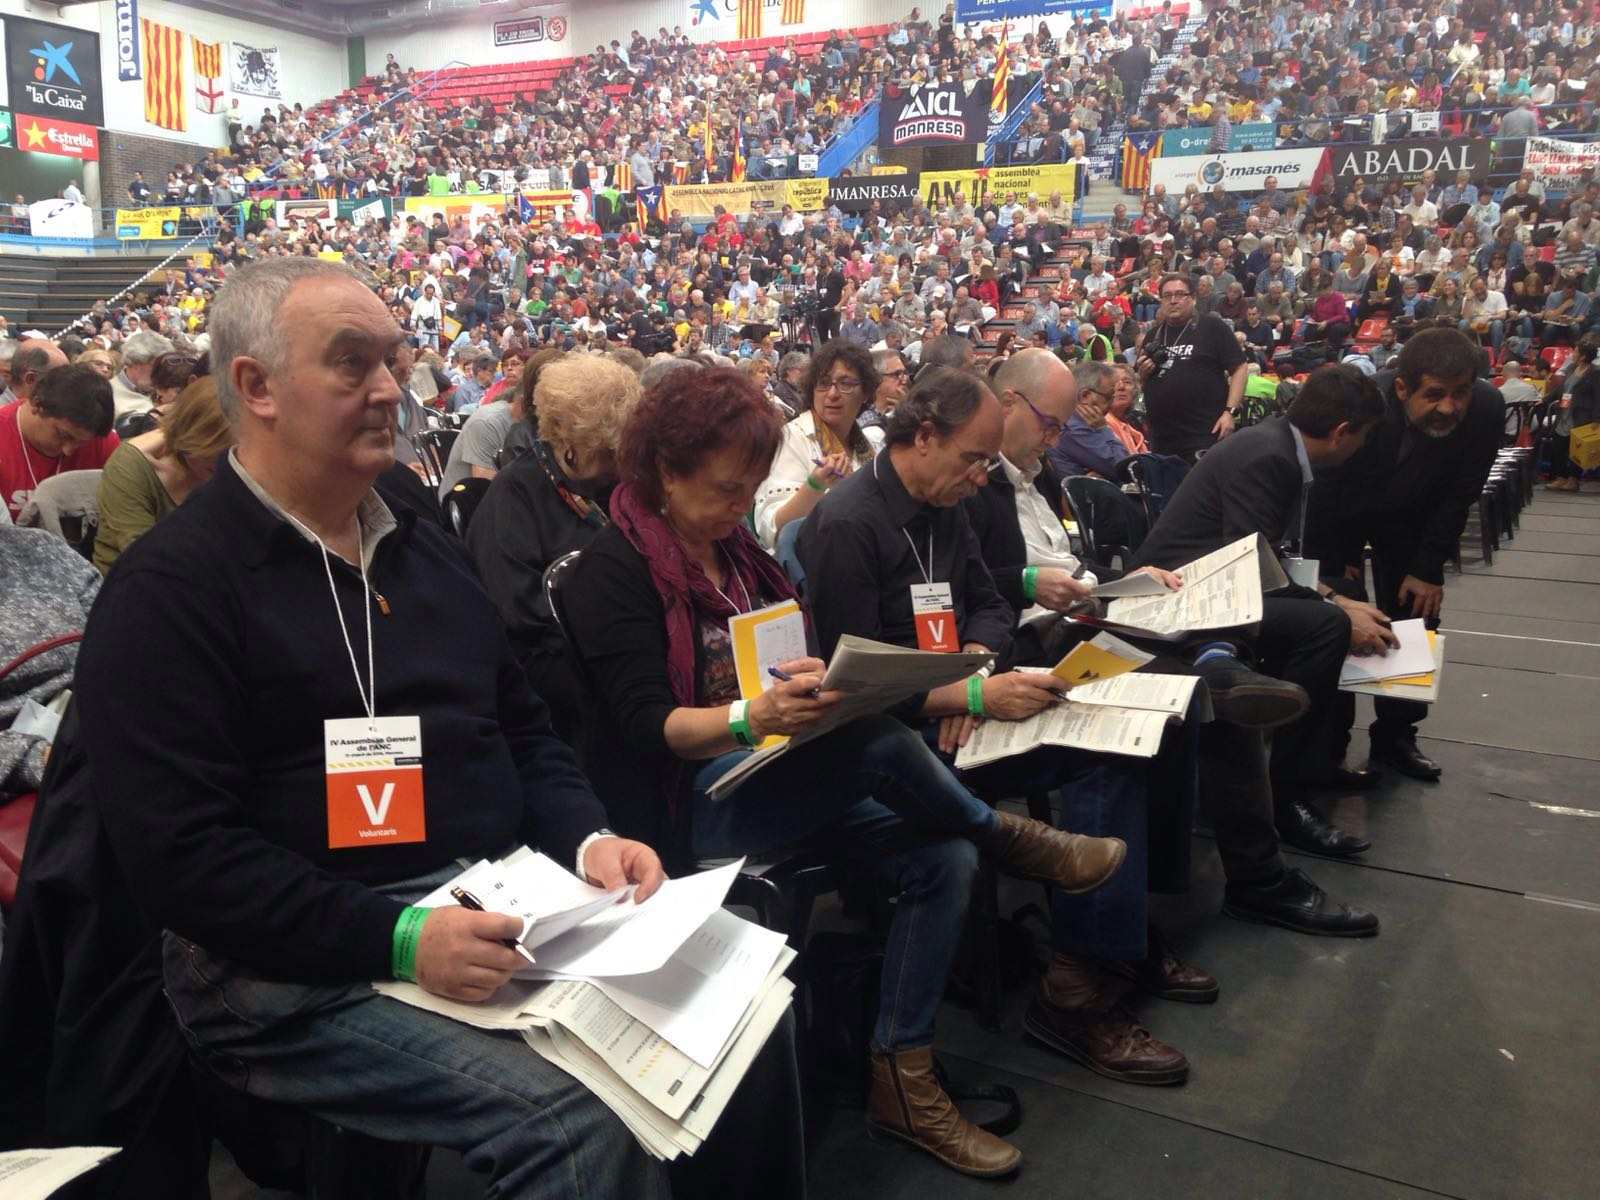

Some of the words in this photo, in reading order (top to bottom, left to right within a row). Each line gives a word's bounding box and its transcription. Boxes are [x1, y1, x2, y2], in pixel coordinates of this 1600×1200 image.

[47, 127, 94, 148] Estrella
[895, 120, 964, 141] MANRESA
[1230, 161, 1301, 177] masanés
[1337, 145, 1476, 177] ABADAL
[994, 168, 1041, 178] assemblea
[994, 179, 1031, 189] nacional
[927, 619, 945, 643] V
[340, 737, 384, 746] Assemblea
[385, 735, 416, 743] General
[356, 782, 396, 826] V
